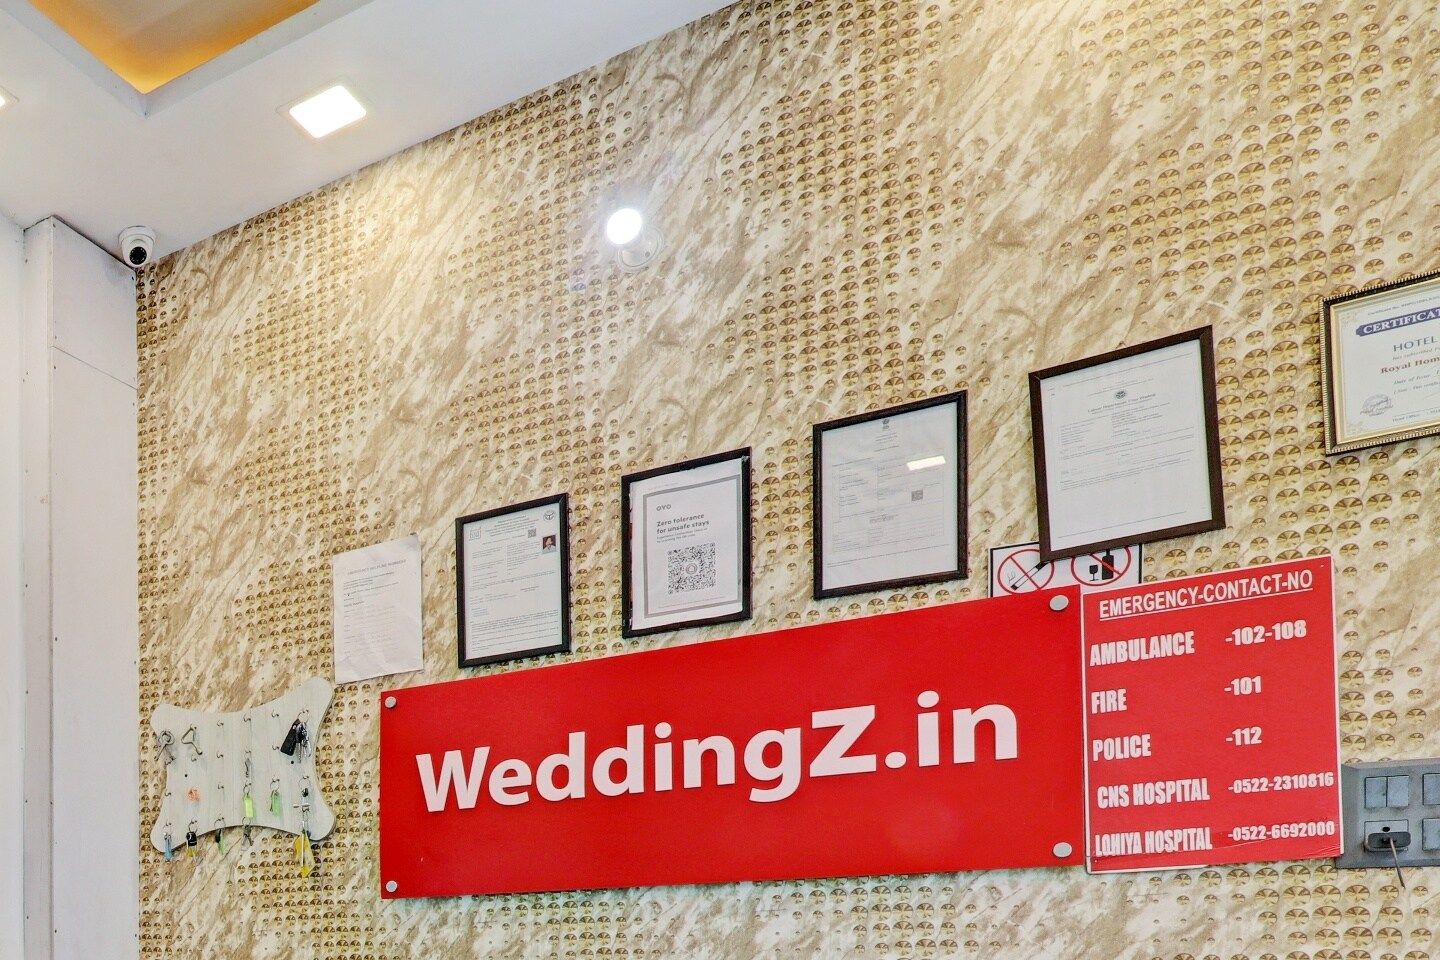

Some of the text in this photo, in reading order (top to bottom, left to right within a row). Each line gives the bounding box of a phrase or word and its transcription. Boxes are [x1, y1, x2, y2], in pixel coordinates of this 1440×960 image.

[1393, 336, 1438, 352] HOTEL
[1381, 362, 1410, 373] Royal
[673, 514, 704, 523] tolerance
[1099, 569, 1313, 619] EMERGENCY-CONTACT-NO
[1090, 619, 1307, 667] AMBULANCE -102-108
[1091, 675, 1262, 714] FIRE -101
[416, 690, 1018, 813] WeddingZ.in
[1092, 726, 1262, 762] POLICE -112
[1097, 772, 1334, 809] CNS HOSPITAL -0522-2310816
[1095, 821, 1335, 857] LOHIYA HOSPITAL -0522-6692000
